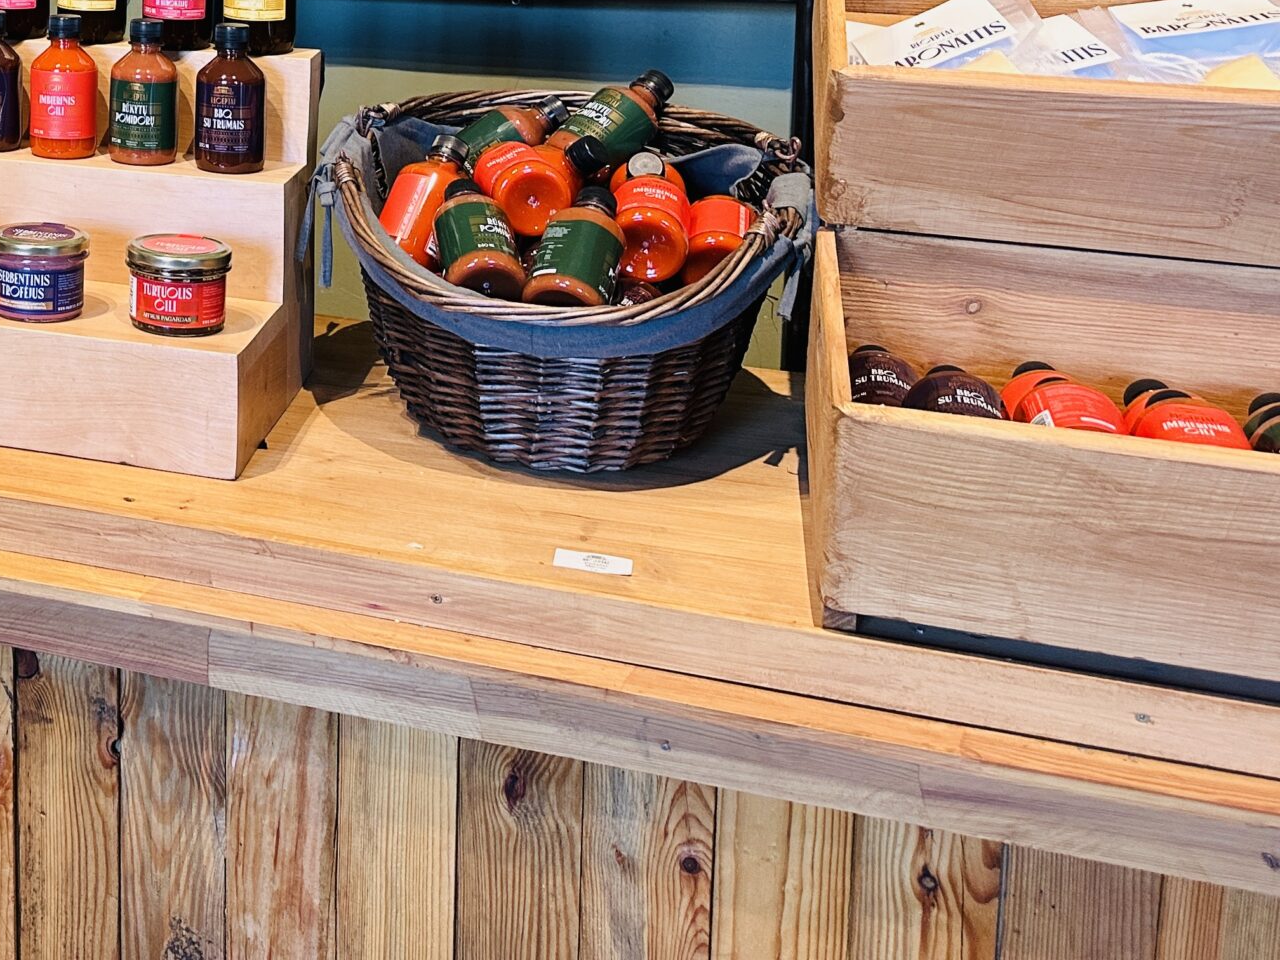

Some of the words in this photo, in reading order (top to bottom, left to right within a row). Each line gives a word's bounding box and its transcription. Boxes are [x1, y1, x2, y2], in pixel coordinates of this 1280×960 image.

[894, 20, 1007, 67] ARONAITIS
[39, 94, 76, 106] IMBIERINIS
[213, 108, 232, 119] BBQ
[115, 112, 155, 127] POMIDORŲ
[203, 119, 211, 128] SU
[212, 119, 245, 130] TRUMAIS
[1, 282, 45, 299] TROFĖJUS
[143, 282, 192, 300] TURTUOLIS
[160, 315, 192, 323] PAGARDAS
[871, 368, 897, 379] BBQ
[855, 375, 868, 386] SU
[937, 395, 953, 405] SU
[956, 388, 985, 404] BBQ
